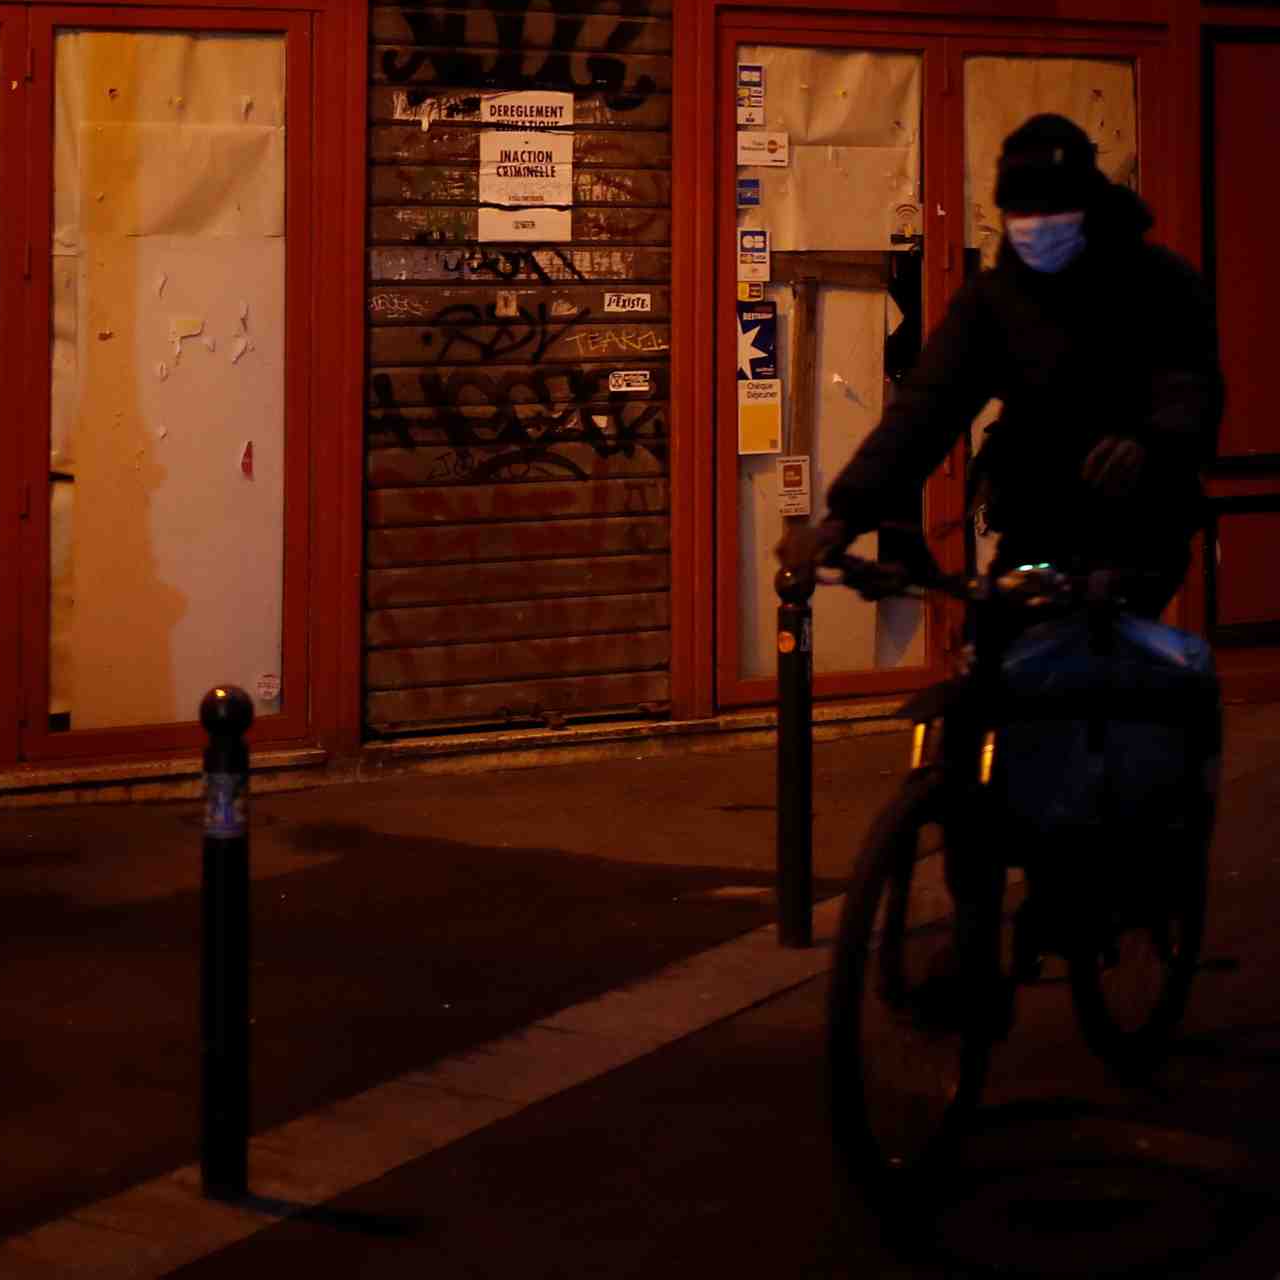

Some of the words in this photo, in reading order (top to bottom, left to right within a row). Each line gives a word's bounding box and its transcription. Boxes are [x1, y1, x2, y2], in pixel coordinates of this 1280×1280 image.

[489, 104, 565, 118] DEREGLEMENT
[500, 150, 553, 163] INACTION
[496, 165, 557, 178] CRIMINELLE
